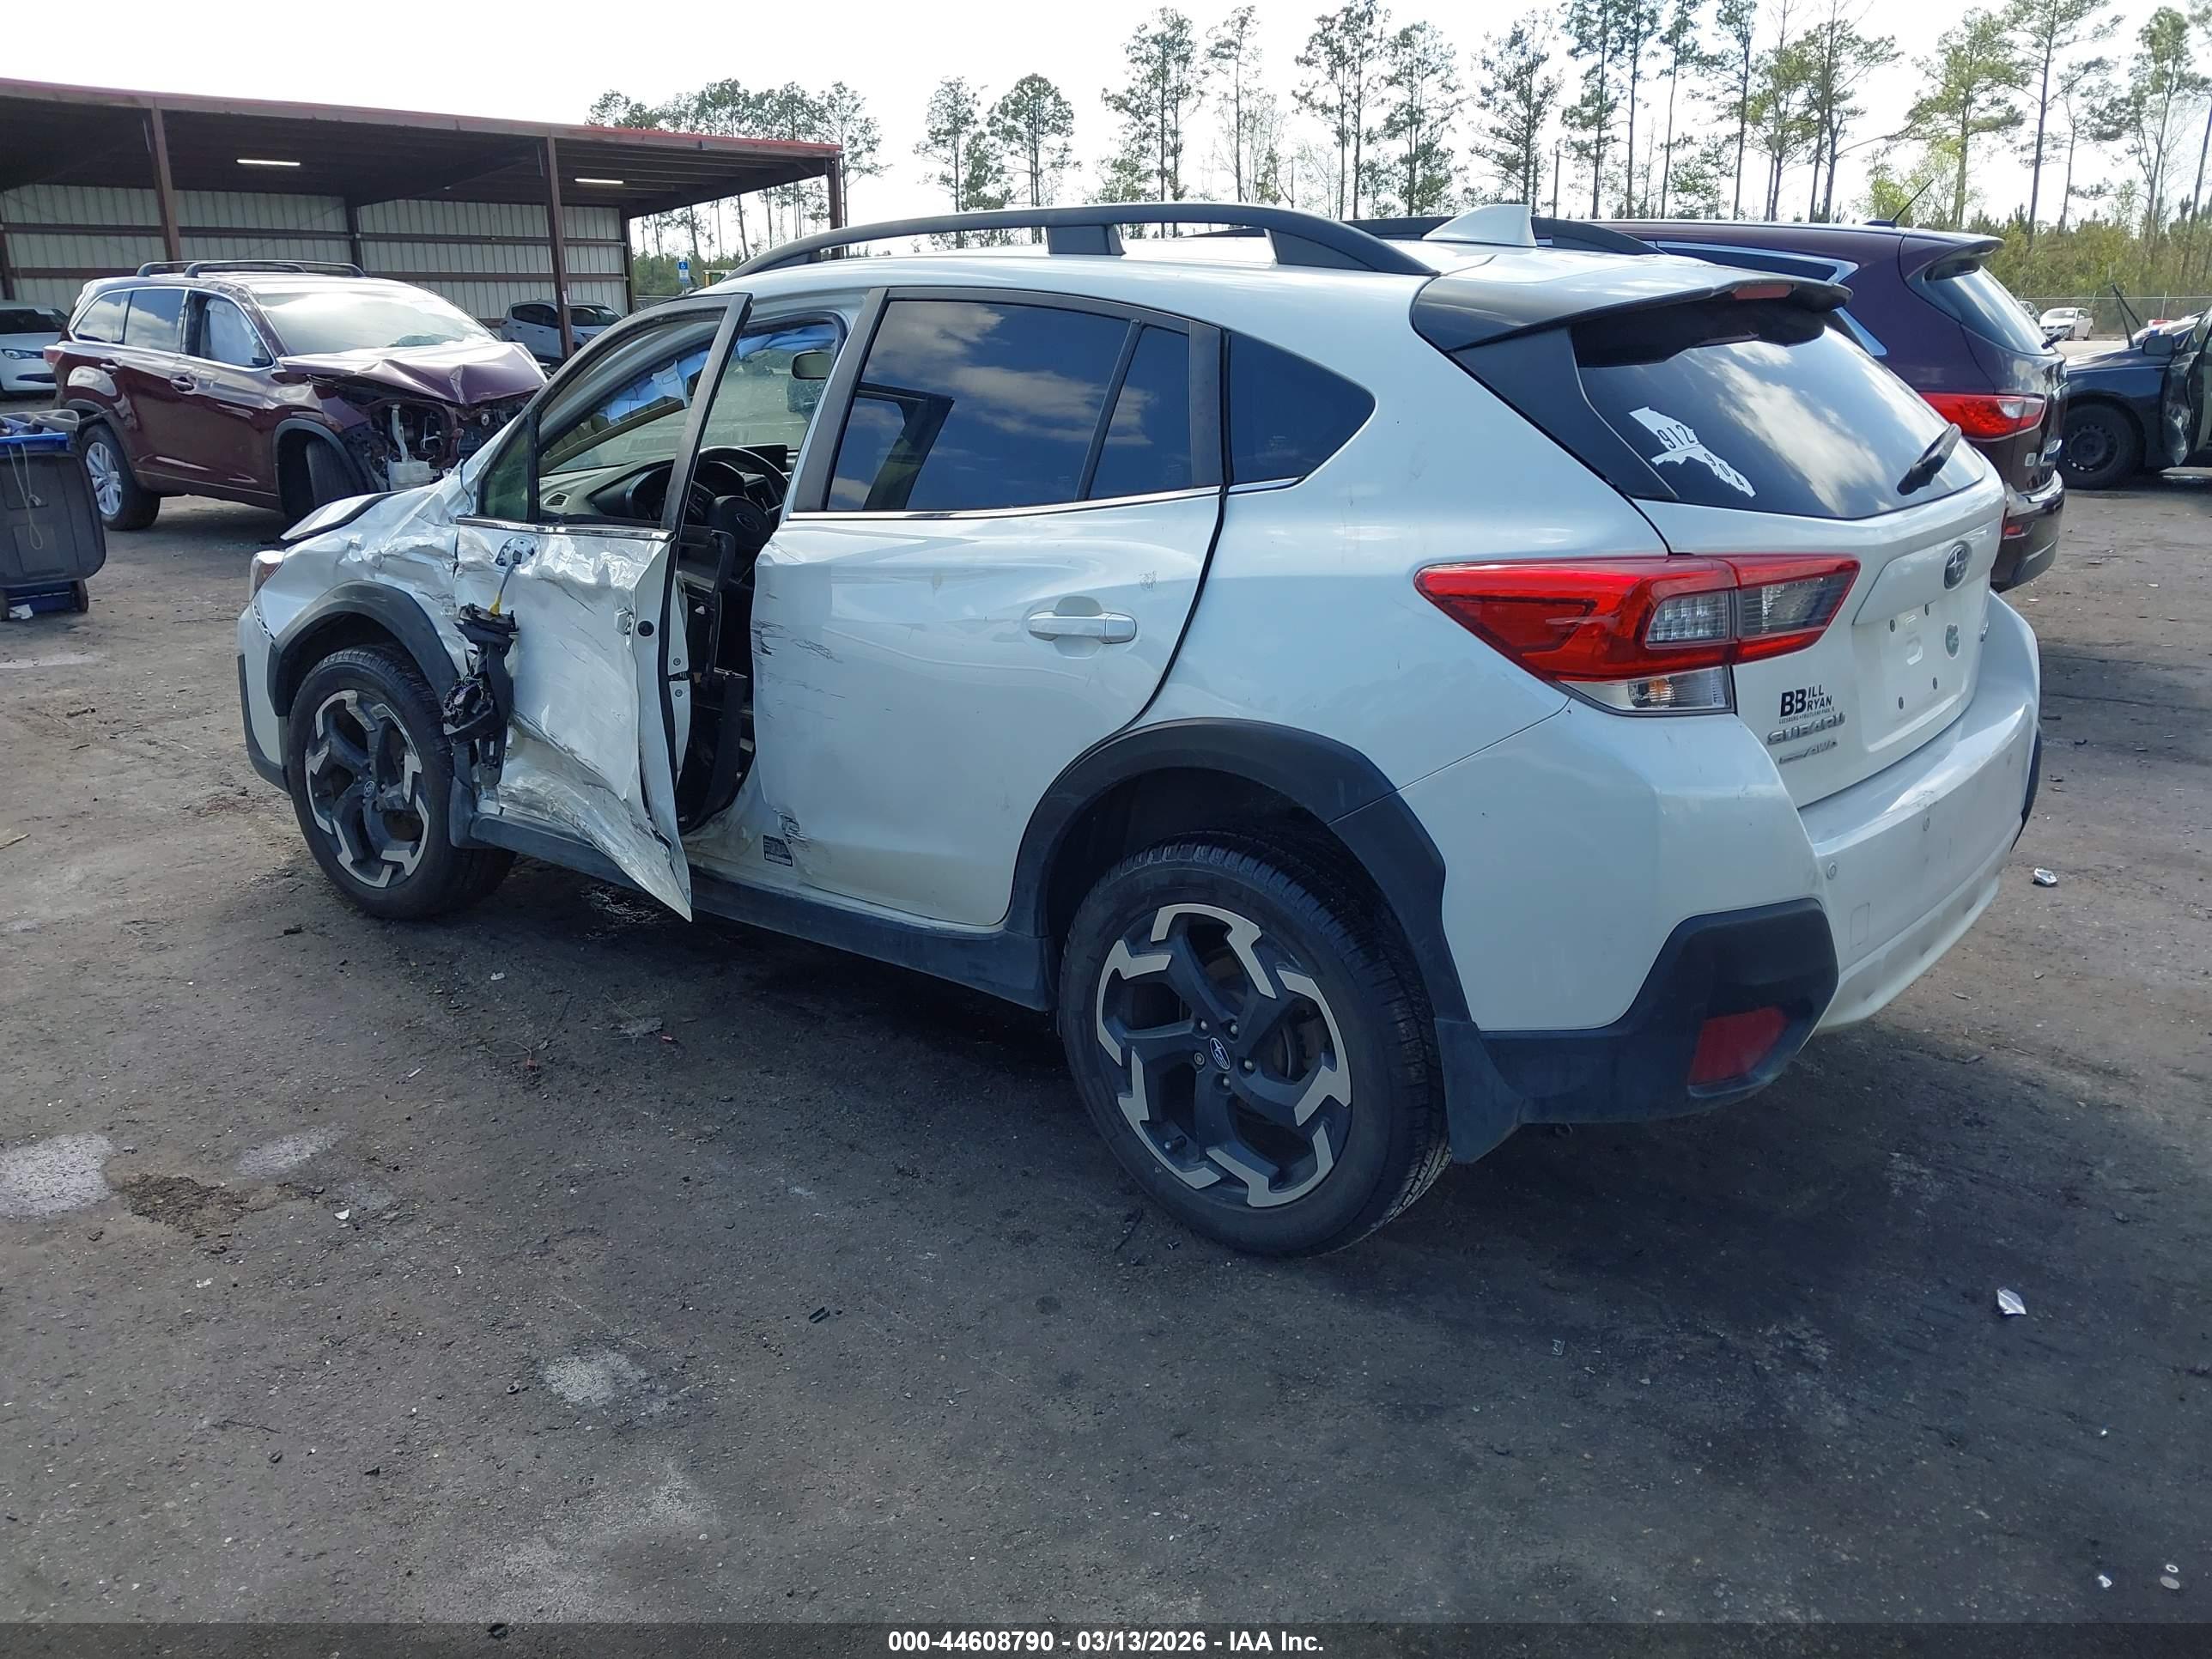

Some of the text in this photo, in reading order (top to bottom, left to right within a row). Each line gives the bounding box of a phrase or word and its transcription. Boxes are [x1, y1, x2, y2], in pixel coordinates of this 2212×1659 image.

[1656, 424, 1696, 449] 912
[1704, 453, 1746, 488] 904
[1767, 712, 1845, 745] SUBARU
